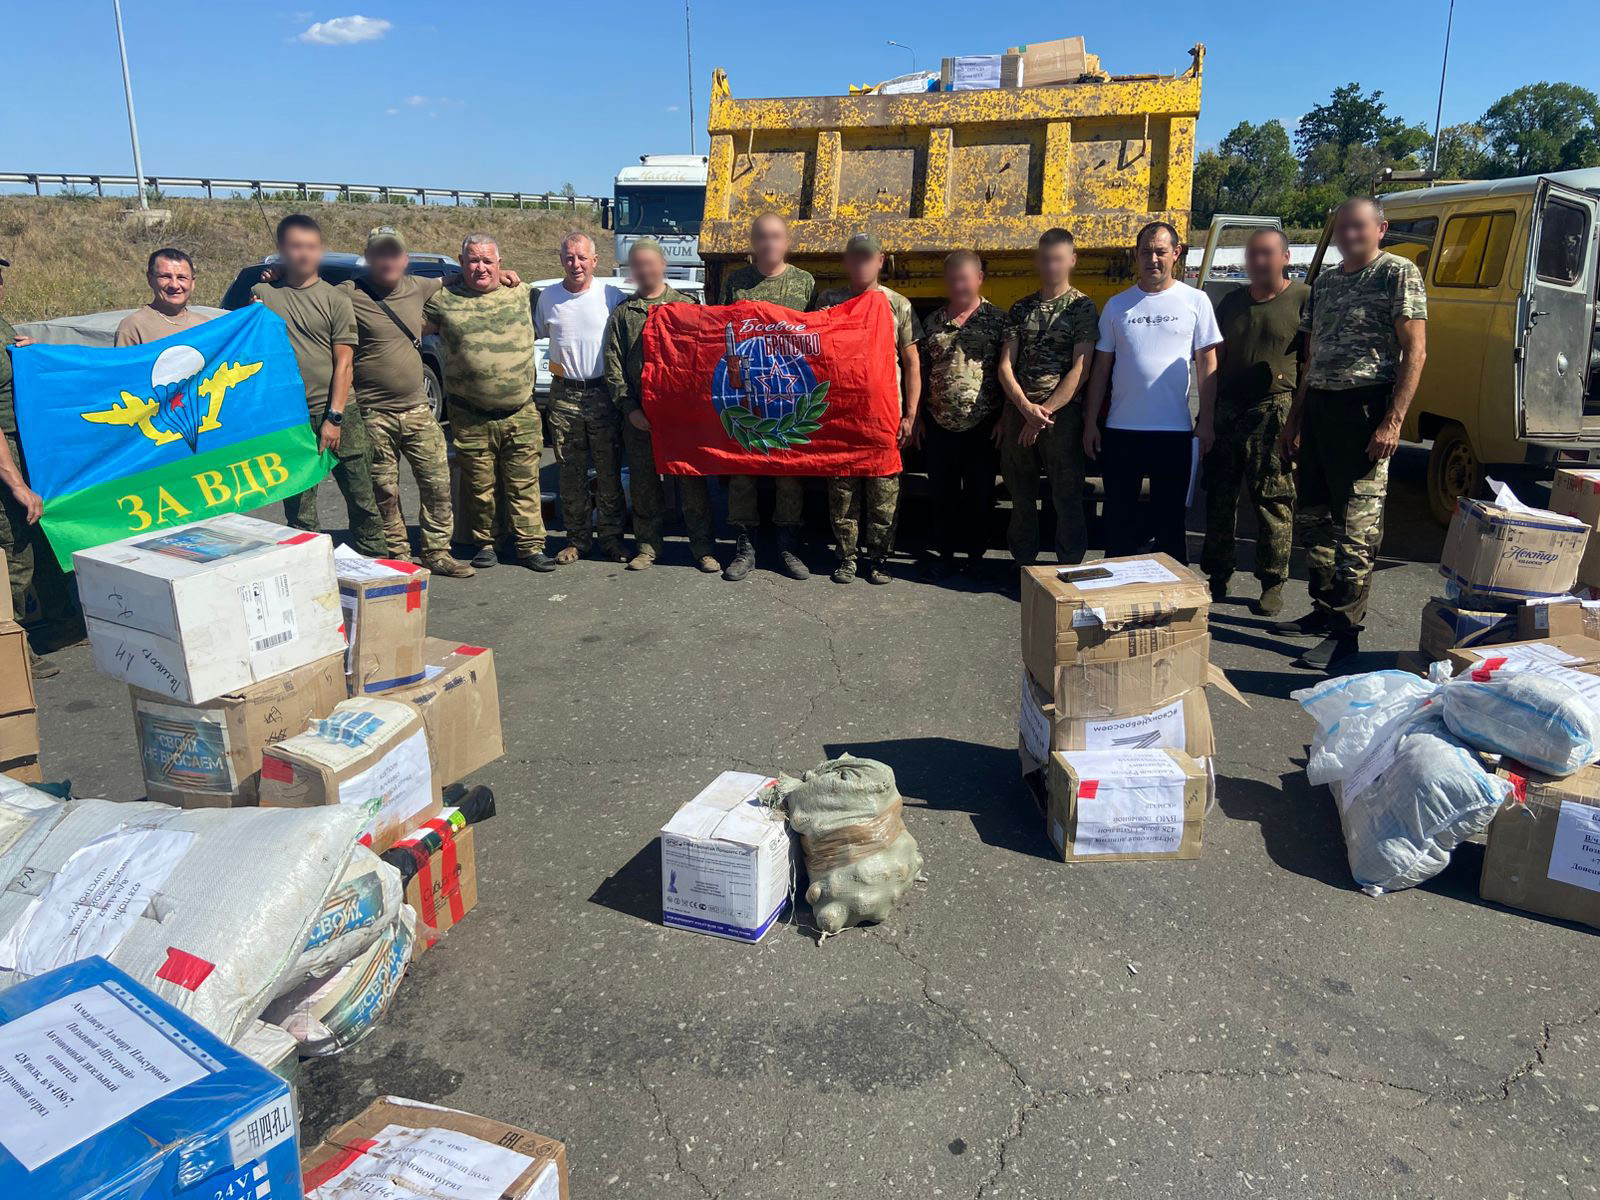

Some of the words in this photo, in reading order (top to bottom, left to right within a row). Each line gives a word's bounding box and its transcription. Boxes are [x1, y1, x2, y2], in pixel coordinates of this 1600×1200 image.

[740, 318, 807, 333] Боевое
[765, 333, 820, 357] БРАТСТВО
[117, 486, 193, 531] ЗА
[192, 452, 289, 508] ВДВ
[1503, 545, 1559, 564] Нектар
[66, 1022, 102, 1050] Позывной
[14, 1052, 31, 1065] 428
[44, 1030, 88, 1064] Автономный
[80, 1061, 121, 1093] дизельный
[45, 1054, 79, 1084] отопитель
[28, 1097, 50, 1117] отряд
